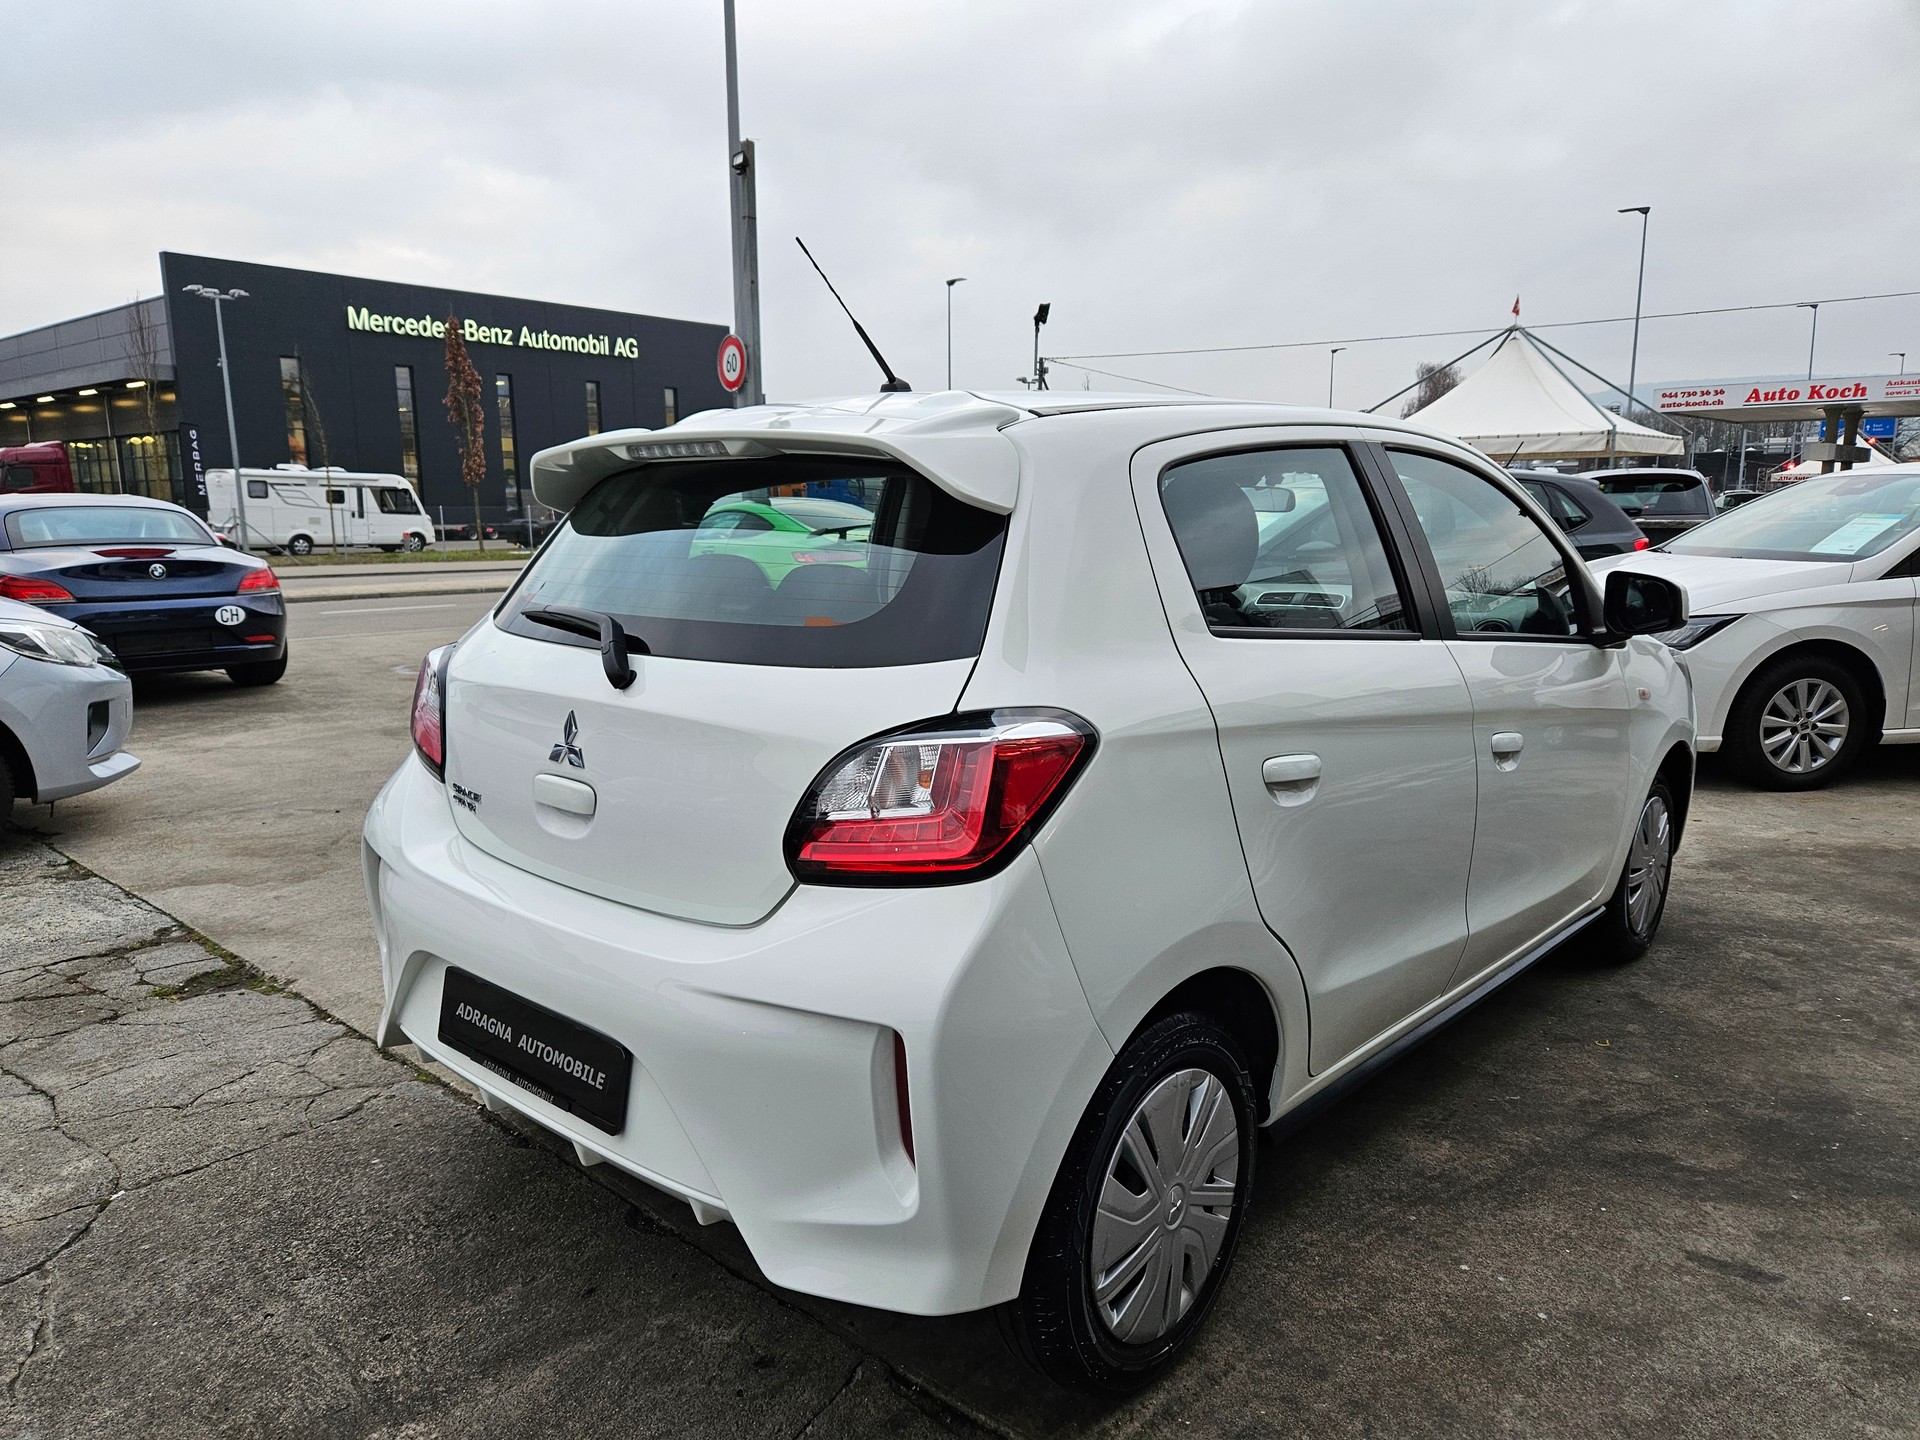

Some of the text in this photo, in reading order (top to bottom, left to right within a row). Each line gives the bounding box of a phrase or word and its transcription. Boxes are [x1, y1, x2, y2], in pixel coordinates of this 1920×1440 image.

[519, 325, 609, 356] Automobil
[614, 336, 639, 359] AG
[726, 353, 738, 373] 60
[1661, 388, 1726, 399] 044 730 36 36
[1744, 383, 1868, 403] Auto Koch
[1660, 399, 1724, 409] auto-koch.ch
[189, 429, 207, 496] MERBAG
[220, 608, 240, 623] CH
[455, 1002, 607, 1091] ADRAGNA AUTOMOBILE
[482, 1060, 555, 1104] ADRAGNA AUTOMOBILE
